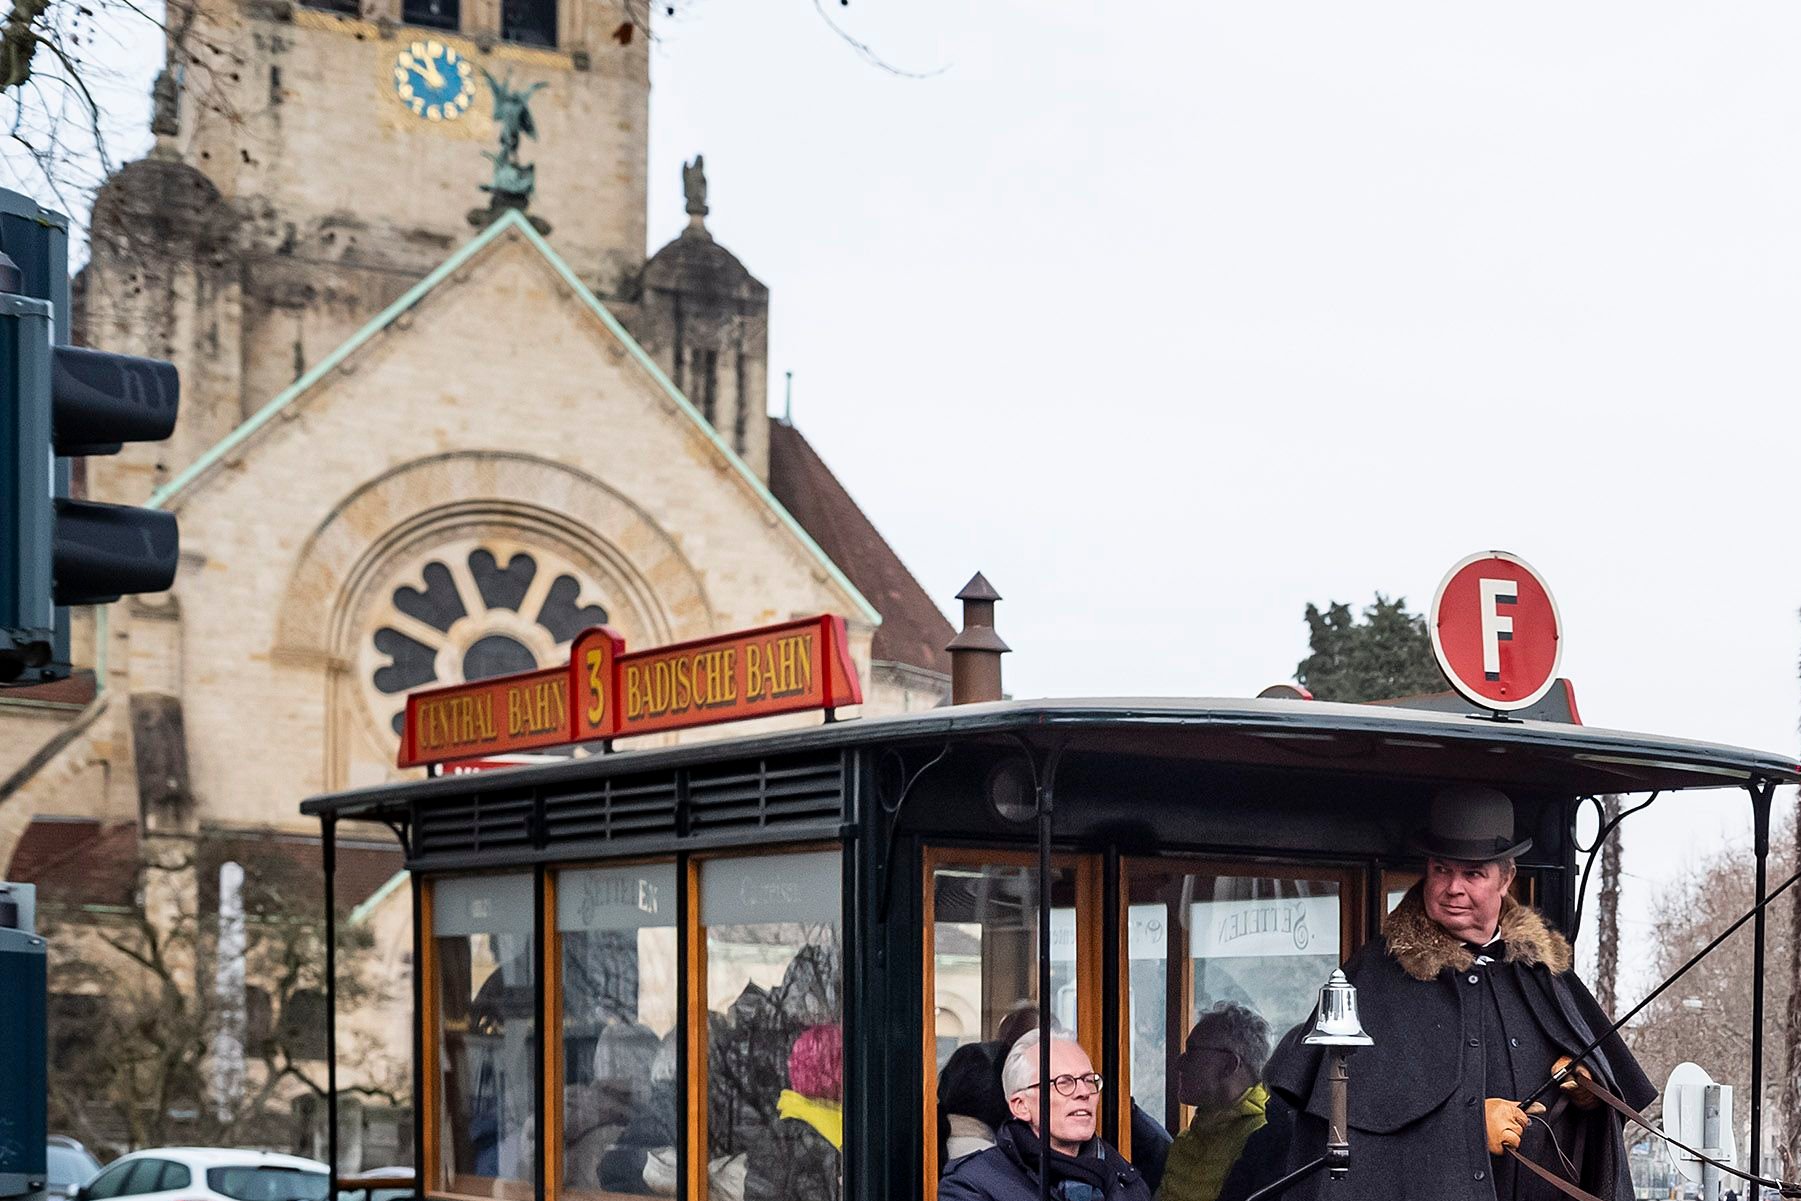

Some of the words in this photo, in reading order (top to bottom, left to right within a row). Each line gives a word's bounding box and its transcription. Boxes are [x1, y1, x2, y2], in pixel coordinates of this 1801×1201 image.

[1479, 578, 1518, 681] F
[418, 691, 497, 748] CENTRAL
[507, 681, 567, 736] BAHN
[585, 648, 605, 727] 3
[627, 654, 737, 720] BADISCHE
[746, 635, 813, 704] BAHN
